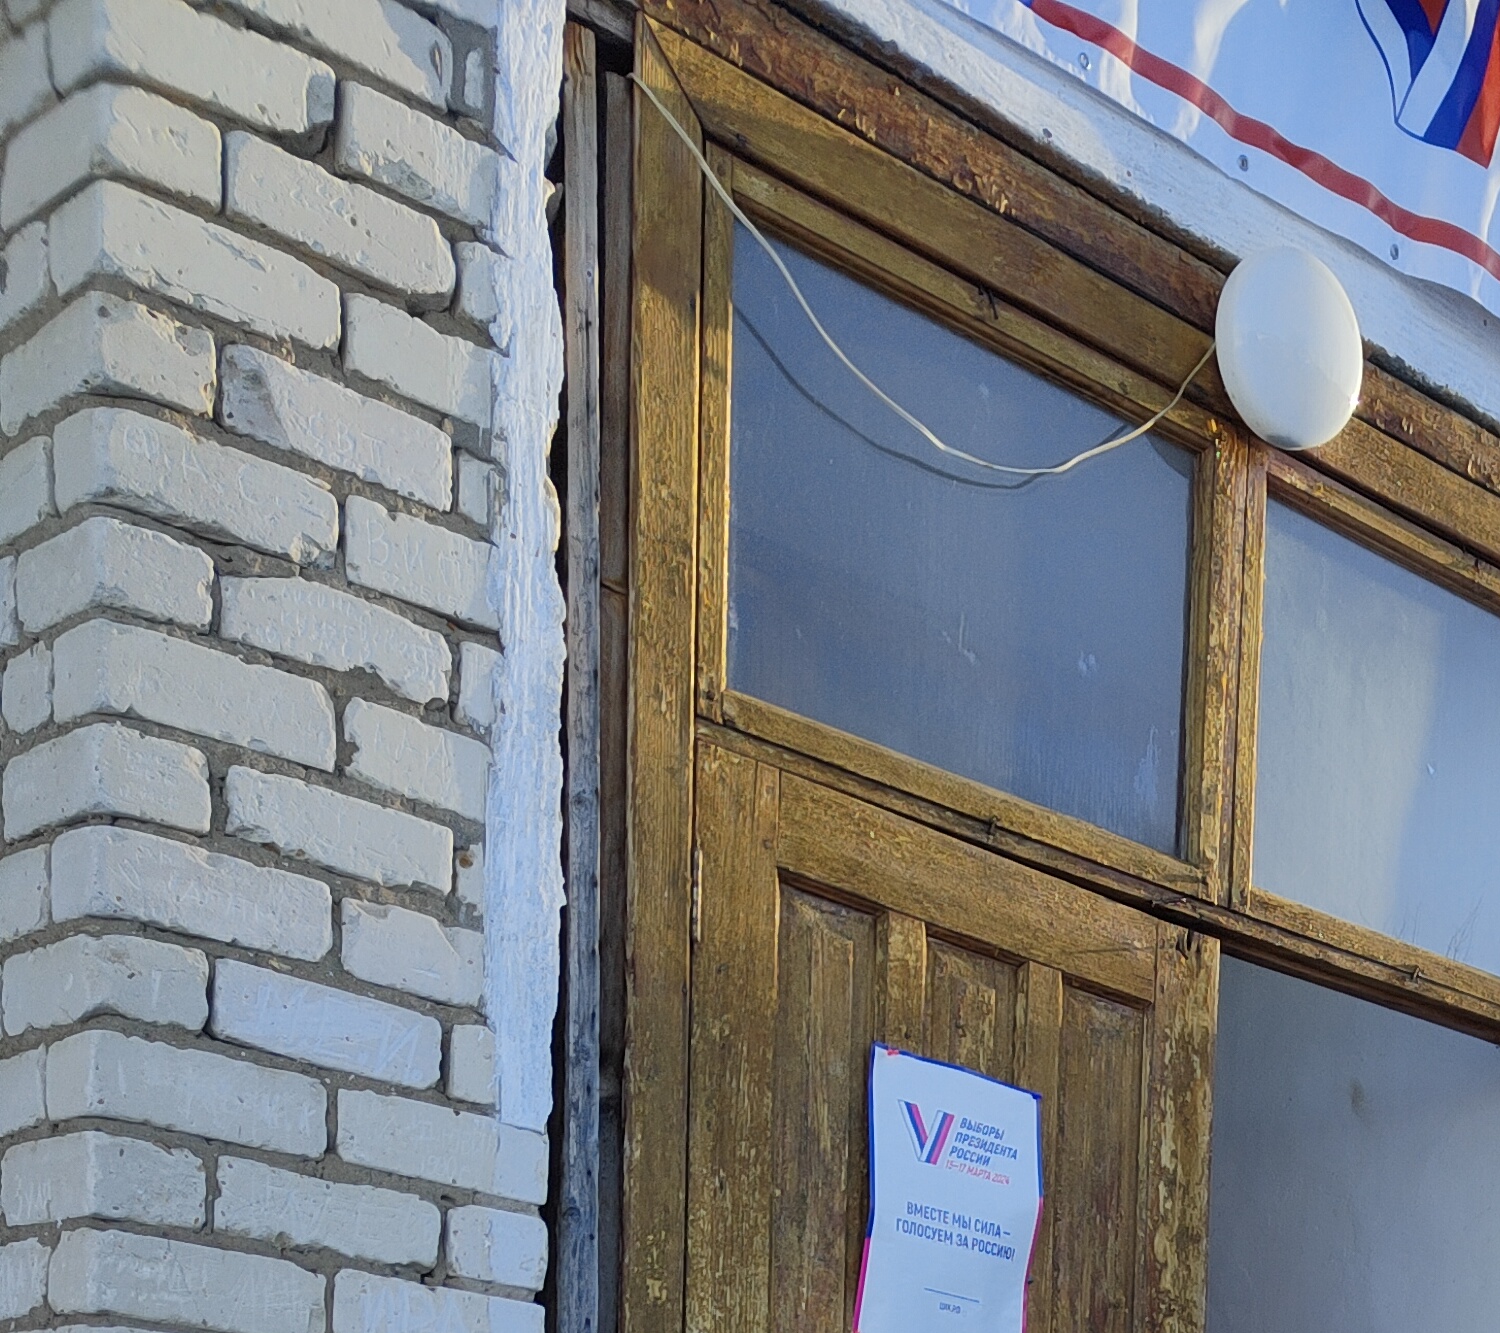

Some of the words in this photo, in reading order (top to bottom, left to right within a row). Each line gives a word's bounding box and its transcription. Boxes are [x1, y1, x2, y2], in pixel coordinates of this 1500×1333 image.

[960, 1117, 1005, 1141] ВЫБОРЫ
[949, 1145, 991, 1167] РОССИИ
[954, 1131, 1018, 1160] ПРЕЗИДЕНТА
[966, 1165, 991, 1180] МАРТА
[906, 1201, 950, 1225] ВМЕСТЕ
[952, 1212, 972, 1231] МЫ
[974, 1218, 1001, 1239] СИЛА
[896, 1217, 953, 1246] ГОЛОСУЕМ
[956, 1233, 969, 1249] ЗА
[971, 1237, 1016, 1261] РОССИЮ!
